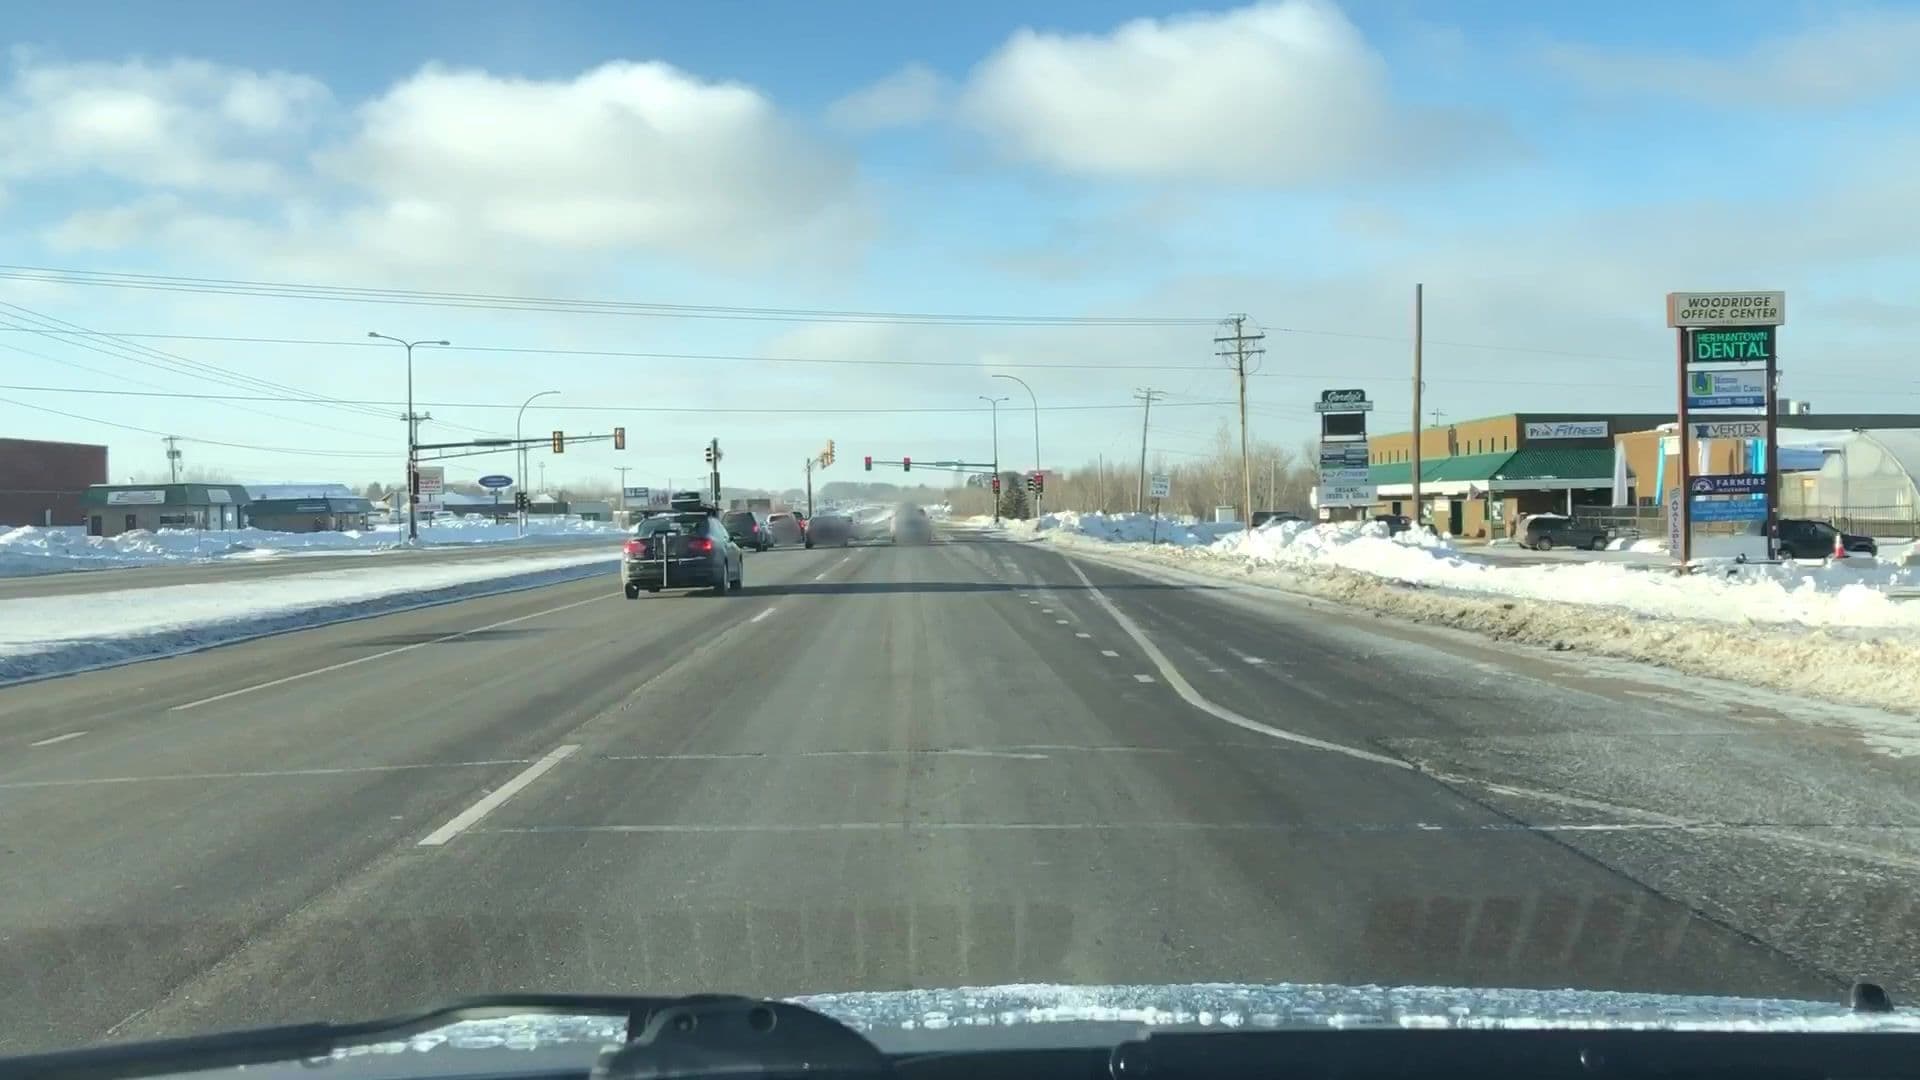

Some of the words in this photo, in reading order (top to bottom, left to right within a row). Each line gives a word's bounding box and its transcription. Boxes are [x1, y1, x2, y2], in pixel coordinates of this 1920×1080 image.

[1688, 297, 1771, 308] WOODRIDGE
[1681, 309, 1724, 319] OFFICE
[1730, 308, 1777, 318] CENTER
[1697, 332, 1768, 342] HERMANTOWN
[1698, 342, 1770, 359] DENTAL
[1711, 423, 1761, 434] VERTEX
[1716, 478, 1766, 487] FARMERS
